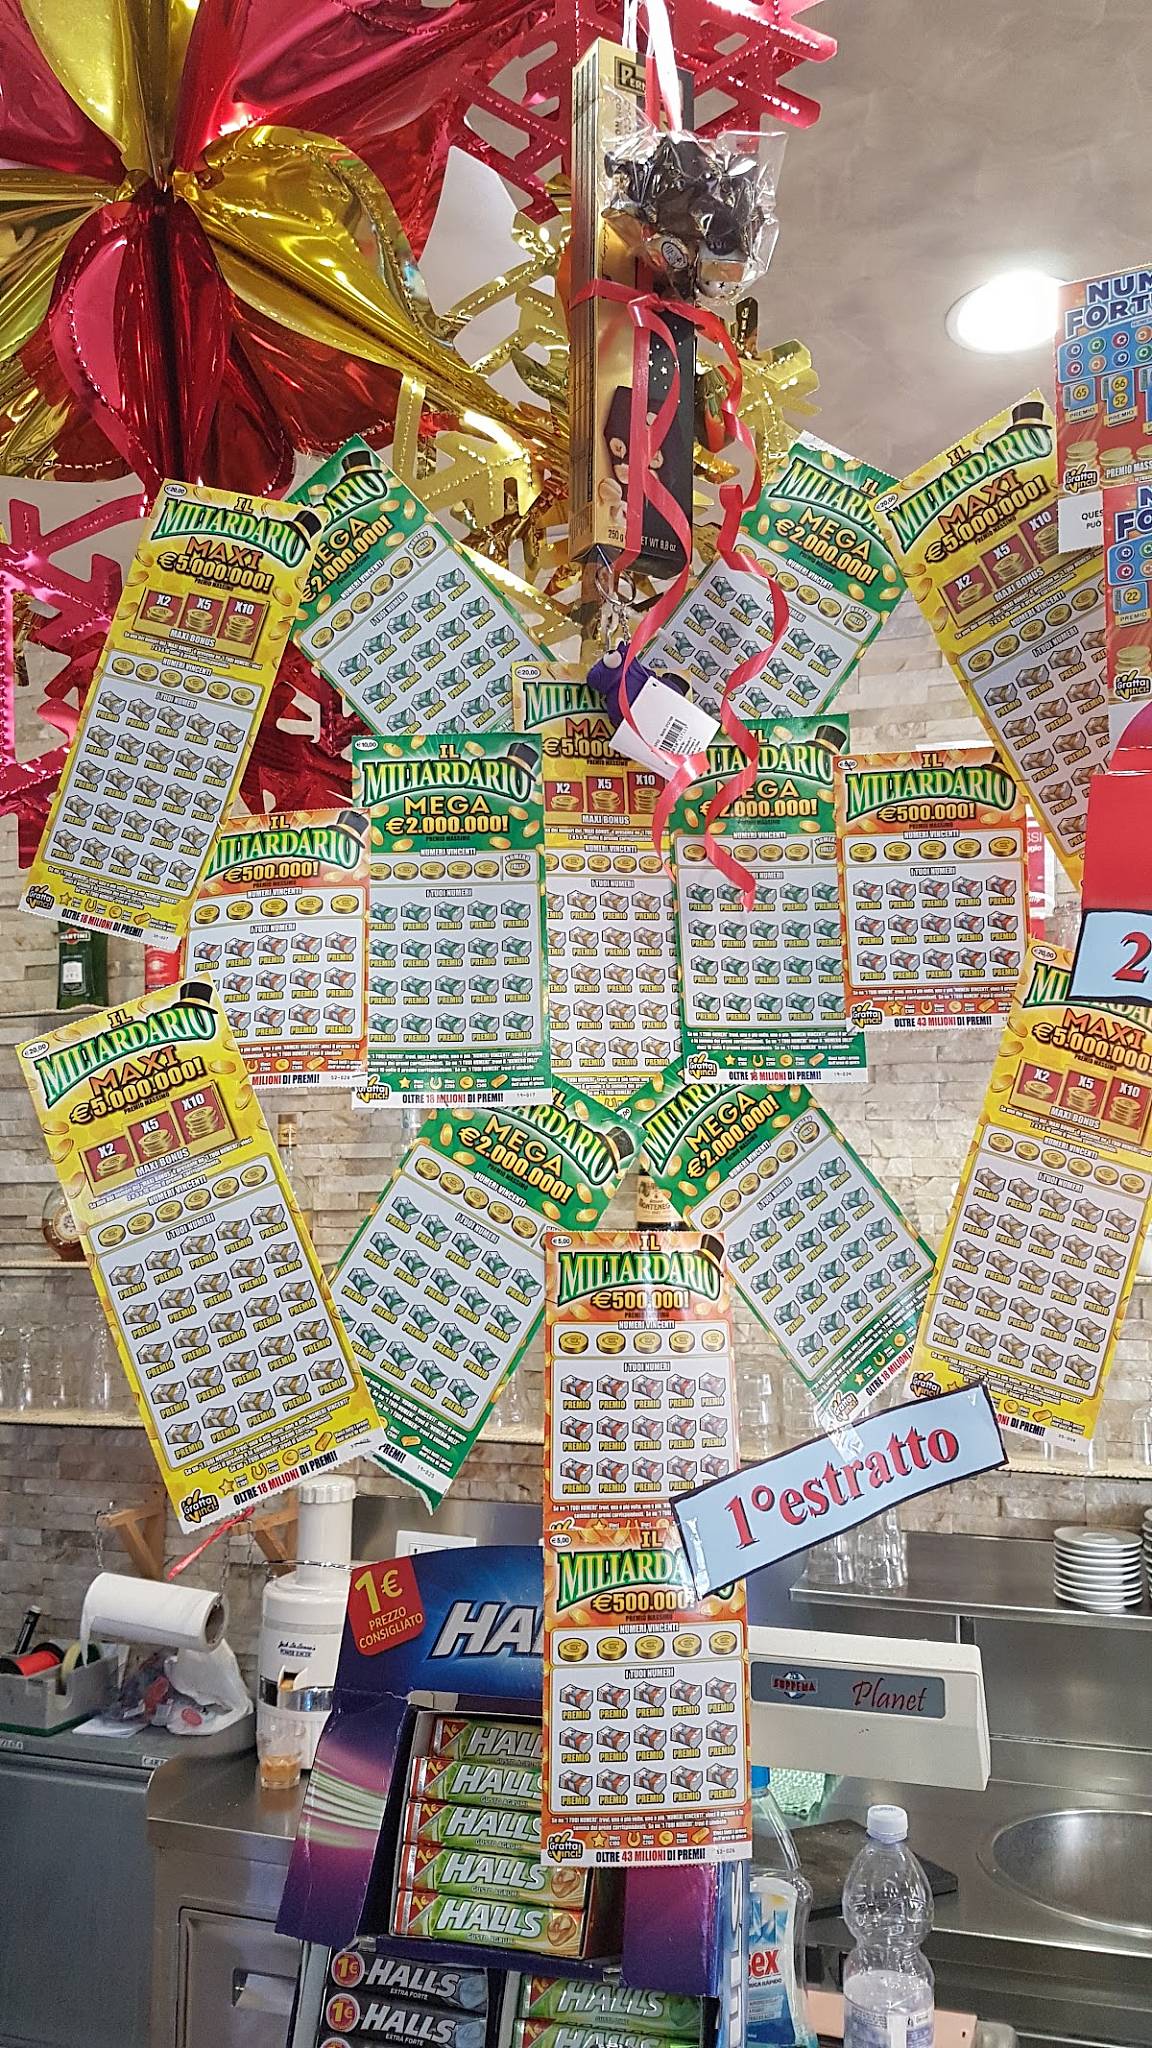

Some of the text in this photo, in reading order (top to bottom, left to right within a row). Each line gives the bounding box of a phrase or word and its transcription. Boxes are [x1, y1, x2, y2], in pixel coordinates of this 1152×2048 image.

[1065, 293, 1152, 338] FORT
[1076, 388, 1087, 398] 65
[1114, 379, 1126, 389] 66
[1114, 396, 1126, 405] 52
[946, 446, 972, 466] IL
[860, 478, 879, 497] IL
[1067, 473, 1093, 484] Gratta
[769, 457, 881, 535] MILIARD
[886, 427, 1053, 554] MILIARDARIO
[937, 469, 1022, 532] MAXI
[235, 497, 253, 513] IL
[924, 475, 1048, 563] €5.000.000!
[1028, 511, 1052, 531] X10
[151, 498, 306, 568] MILIARDARIO
[799, 507, 873, 561] MEGA
[185, 537, 264, 571] MAXI
[300, 515, 394, 604] €2.000.000!
[776, 517, 879, 585] €2.000.000!
[992, 544, 1011, 561] X5
[158, 552, 274, 593] €5.000.000!
[956, 575, 973, 591] X2
[994, 568, 1044, 603] MAXI BONUS
[156, 594, 172, 608] X2
[196, 598, 212, 610] X5
[1126, 591, 1138, 601] 22
[234, 601, 254, 615] X10
[1117, 679, 1146, 690] Gratta
[524, 682, 607, 730] MILIAR
[439, 745, 461, 759] IL
[543, 737, 630, 760] €5.000.
[700, 744, 834, 786] LIADARIO
[921, 754, 943, 768] IL
[362, 759, 532, 807] MILIARDARIO
[556, 782, 571, 794] X2
[597, 778, 612, 790] X5
[635, 774, 656, 786] X10
[846, 767, 1016, 823] MILIARDARIO
[404, 796, 491, 816] MEGA
[877, 802, 976, 823] €500.000!
[269, 816, 290, 830] IL
[385, 816, 509, 835] €2.000.000!
[581, 814, 630, 825] MAXI BONUS
[224, 861, 319, 883] €500.000!
[61, 908, 80, 921] OLTRE
[80, 913, 88, 923] 18
[88, 915, 113, 931] MILIONI
[112, 922, 121, 932] DI
[1111, 931, 1152, 983] 2
[107, 1009, 133, 1028] IL
[894, 1016, 992, 1027] OLTRE 43 MILIONI DI PREMI!
[1064, 1008, 1147, 1049] MAXI
[35, 1006, 216, 1109] MILIARDARIO
[89, 1045, 180, 1097] MAXI
[729, 1071, 749, 1080] OLTRE
[759, 1071, 787, 1081] MILIONI
[787, 1071, 796, 1080] DI
[796, 1070, 822, 1080] PREMI!
[1034, 1069, 1050, 1082] X2
[70, 1056, 206, 1125] €5.000.000!
[1077, 1076, 1094, 1089] X5
[1119, 1082, 1140, 1098] X10
[181, 1093, 205, 1111] X10
[402, 1093, 425, 1104] OLTRE
[436, 1093, 466, 1103] MILIONI
[467, 1093, 476, 1103] DI
[477, 1092, 504, 1103] PREMI!
[141, 1120, 159, 1134] X5
[684, 1091, 757, 1153] MEGA
[1050, 1107, 1101, 1129] MAXI BONUS
[642, 1083, 735, 1174] MILIARD
[686, 1093, 780, 1178] €2.000.000!
[97, 1144, 116, 1159] X2
[485, 1115, 563, 1177] MEGA
[497, 1104, 615, 1187] ARDARIO
[135, 1148, 190, 1176] MAXI BONUS
[458, 1126, 574, 1206] €2.000.000!
[148, 1175, 208, 1205] NUMERI VINCENTI
[260, 1221, 288, 1239] PREMIO
[415, 1232, 441, 1251] PREMIO
[639, 1234, 660, 1252] IL
[557, 1251, 721, 1307] MILIARDARIO
[119, 1282, 147, 1300] PREMIO
[591, 1289, 690, 1310] €500.000!
[618, 1321, 675, 1330] NUMERI VINCENTI
[866, 1351, 911, 1396] OLTRE 18 MILIONI
[563, 1400, 591, 1410] PREMIO
[233, 1450, 338, 1506] OLTRE 18 MILIONI DI PREMI!
[184, 1496, 213, 1515] Gratta
[640, 1530, 664, 1548] IL
[557, 1549, 695, 1613] MILIARDA
[368, 1607, 407, 1631] PREZZO
[619, 1623, 680, 1634] NUMERI VINCENTI
[359, 1612, 424, 1650] CONSIGLIATO
[852, 1677, 928, 1712] Planet
[562, 1710, 591, 1720] PREMIO
[636, 1708, 665, 1718] PREMIO
[708, 1703, 735, 1713] PREMIO
[464, 1726, 542, 1764] HALL
[599, 1752, 628, 1762] PREMIO
[673, 1792, 700, 1802] PREMIO
[550, 1842, 578, 1850] Gratta
[596, 1851, 620, 1863] OLTRE
[621, 1851, 632, 1862] 43
[634, 1850, 666, 1861] MILIONI
[667, 1850, 676, 1860] DI
[677, 1849, 706, 1860] PREMI!
[440, 1850, 548, 1891] HALLS
[435, 1898, 544, 1939] HALLS
[749, 1949, 779, 1978] ex
[365, 1957, 461, 1999] HALLS
[390, 1988, 429, 2000] EXTRA FORTE
[556, 1981, 667, 2018] HALLS
[361, 2002, 457, 2045] HALLS
[385, 2033, 424, 2046] EXTRA FORTE
